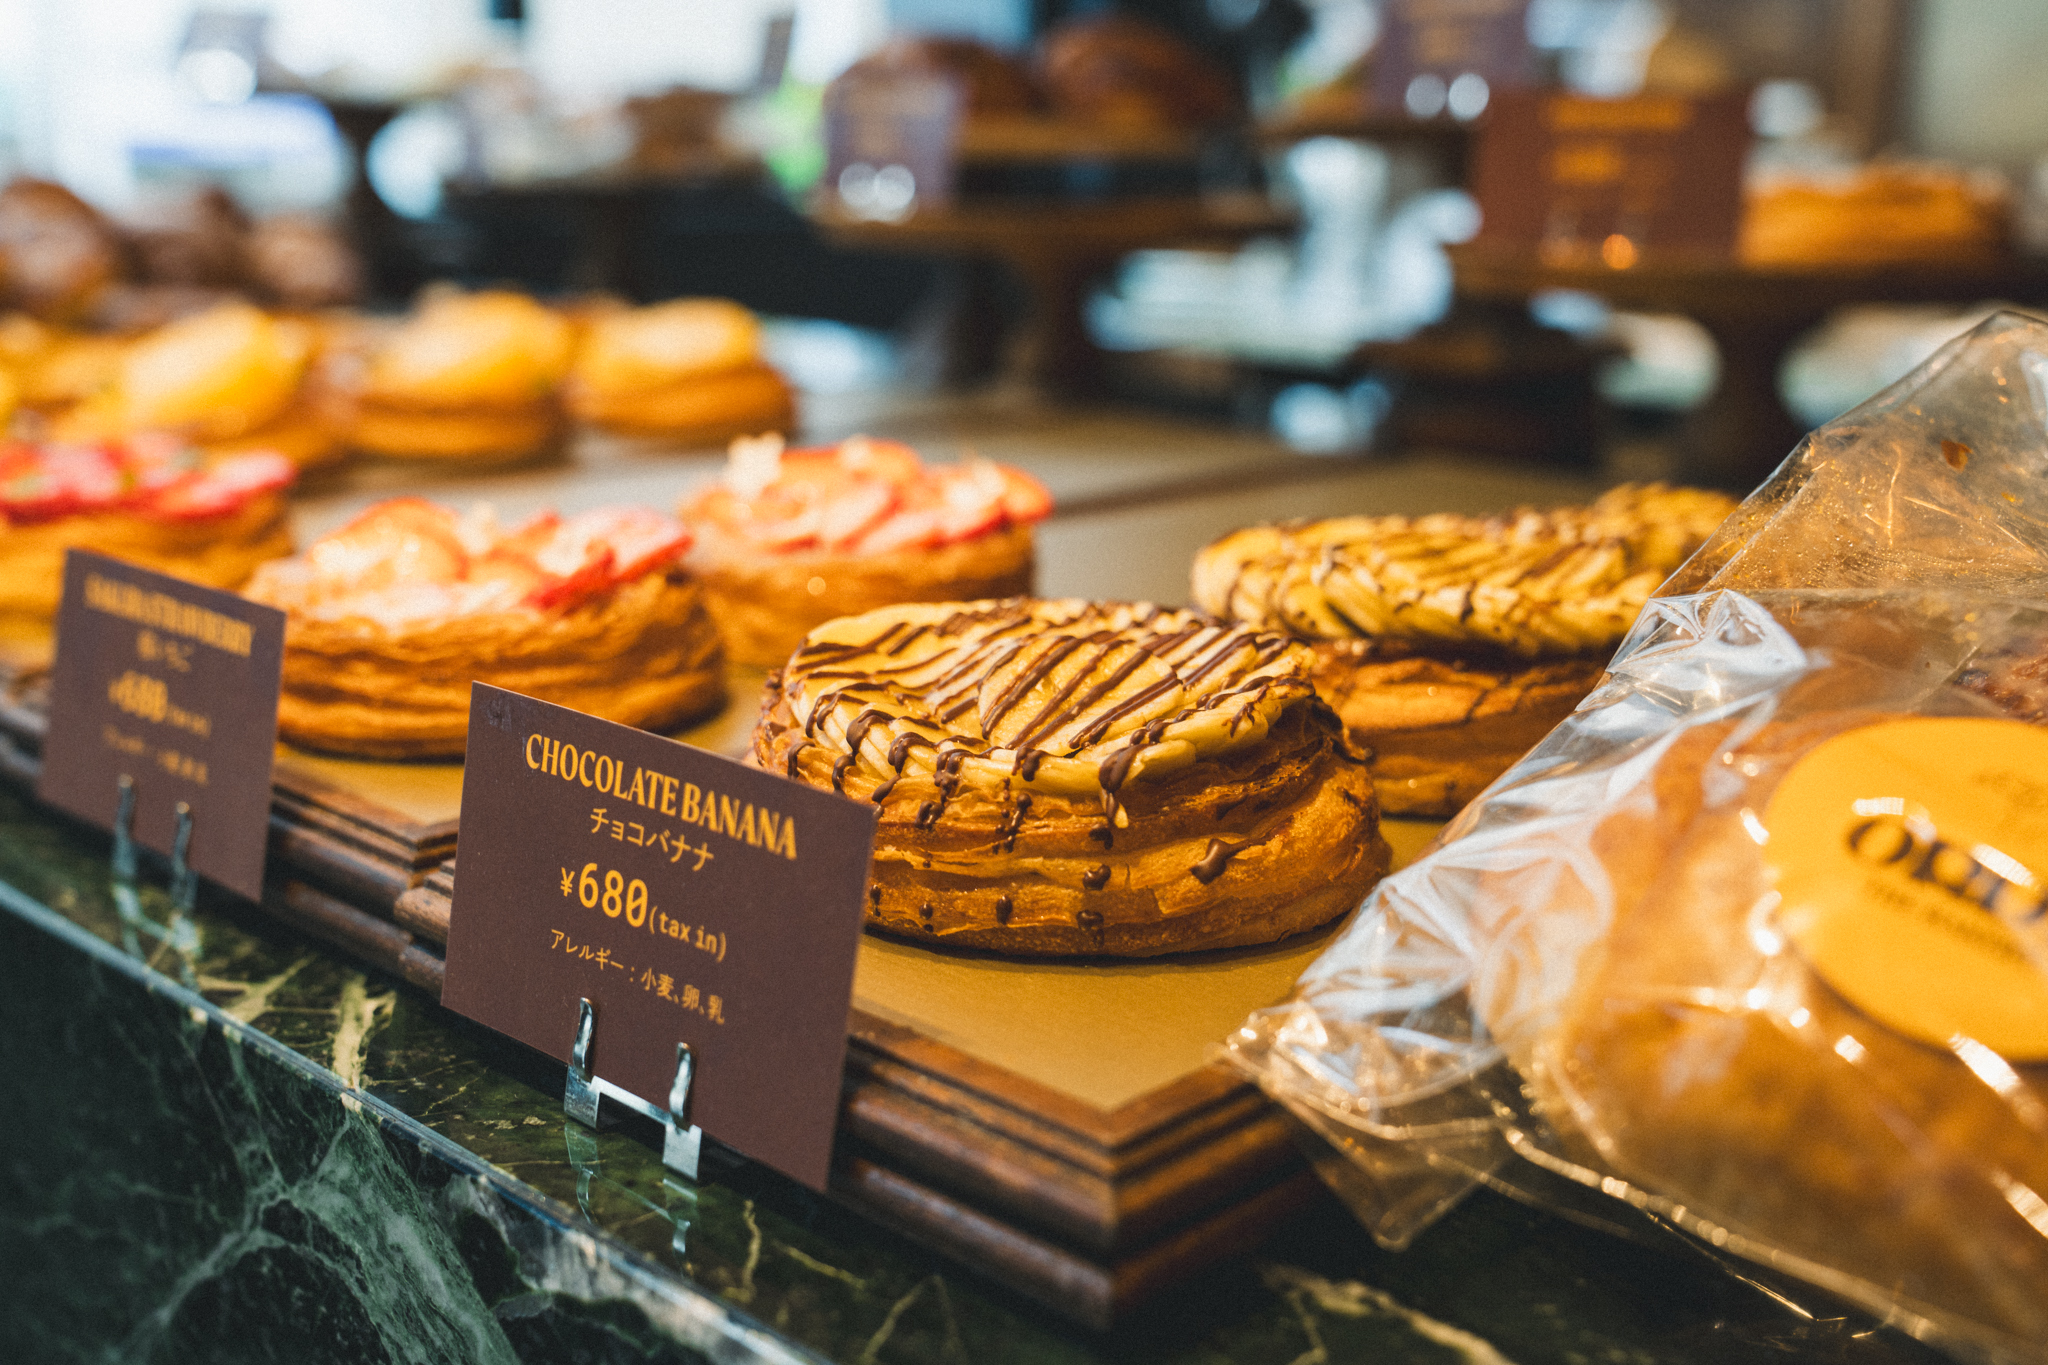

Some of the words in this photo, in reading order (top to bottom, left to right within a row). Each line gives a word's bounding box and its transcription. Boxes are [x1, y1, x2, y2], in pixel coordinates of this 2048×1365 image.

[525, 733, 680, 817] CHOCOLATE
[681, 782, 798, 861] BANANA
[590, 807, 715, 872] チョコバナナ
[560, 862, 648, 928] ¥680
